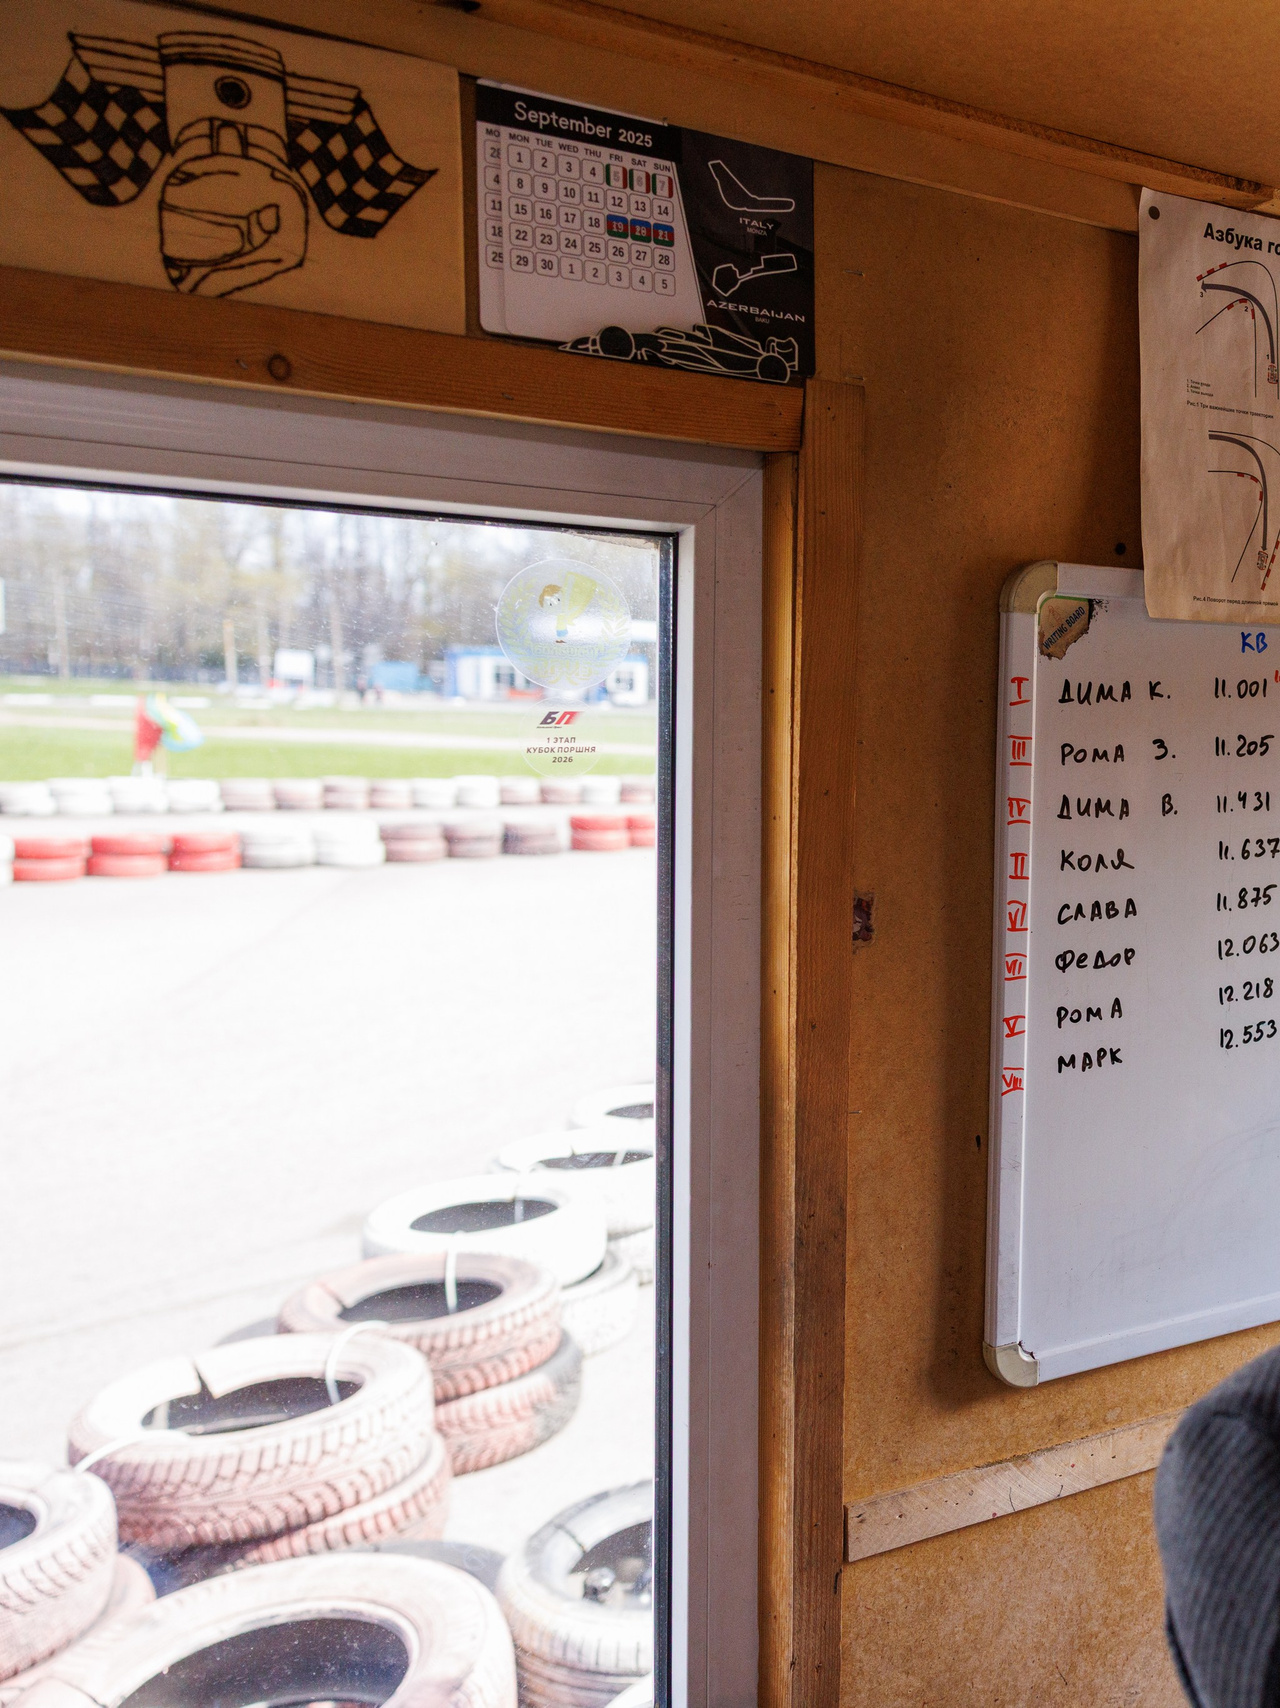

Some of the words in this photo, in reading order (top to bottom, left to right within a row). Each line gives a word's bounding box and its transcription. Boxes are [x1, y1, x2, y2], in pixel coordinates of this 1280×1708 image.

[514, 101, 612, 138] September
[618, 129, 653, 147] 2025
[509, 133, 530, 143] MON
[536, 138, 553, 148] TUE
[558, 143, 579, 153] WED
[584, 148, 602, 158] THU
[609, 153, 623, 162] FRI
[631, 158, 648, 167] SAT
[653, 163, 671, 172] SUN
[517, 152, 523, 162] 1
[541, 157, 548, 168] 2
[566, 162, 572, 172] 3
[589, 167, 596, 177] 4
[517, 178, 523, 188] 8
[542, 183, 548, 193] 9
[564, 187, 576, 198] 10
[588, 192, 599, 203] 11
[611, 197, 623, 208] 12
[634, 201, 646, 212] 13
[657, 206, 669, 216] 14
[739, 218, 774, 229] ITALY
[747, 227, 767, 236] MONZA
[1203, 222, 1263, 252] Азбука
[515, 230, 528, 241] 22
[540, 234, 552, 245] 23
[564, 238, 577, 249] 24
[589, 242, 601, 253] 25
[612, 246, 624, 257] 26
[636, 250, 647, 261] 27
[658, 254, 670, 265] 28
[707, 300, 805, 322] AZERBAIJAN
[1043, 624, 1068, 650] WRITING
[1065, 606, 1086, 628] BOARD
[1241, 631, 1268, 653] КВ
[1058, 679, 1131, 705] ДИМА
[1214, 677, 1267, 699] 11.001
[1060, 742, 1125, 765] РОМА
[1215, 734, 1275, 757] 11.205
[1057, 794, 1130, 820] ДИМА
[1217, 791, 1270, 813] 11.431
[1218, 838, 1280, 861] 11.637
[1057, 898, 1137, 925] СЛАВА
[1217, 884, 1277, 912] 11.875
[1218, 932, 1280, 960] 12.063
[1056, 997, 1122, 1028] РОМА
[1219, 977, 1274, 1005] 12.218
[1057, 1048, 1122, 1073] МАРК
[1220, 1020, 1277, 1050] 12.553
